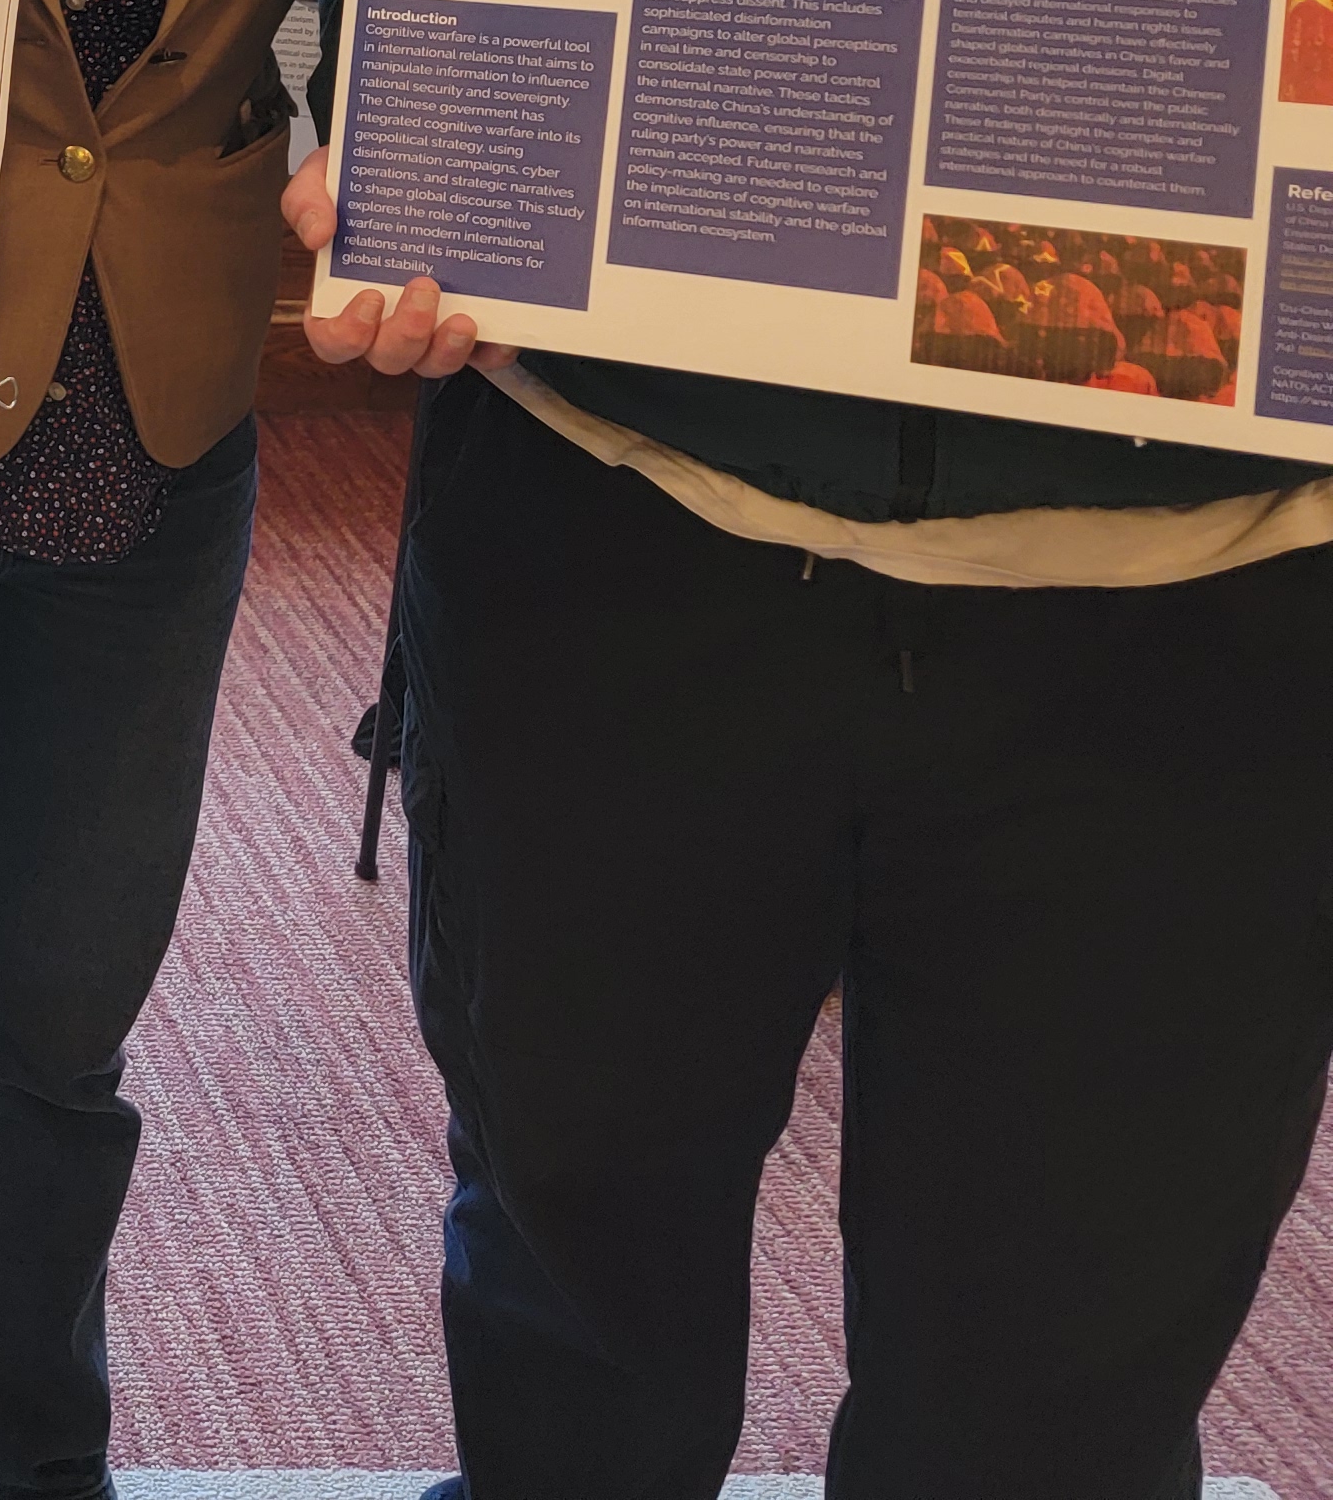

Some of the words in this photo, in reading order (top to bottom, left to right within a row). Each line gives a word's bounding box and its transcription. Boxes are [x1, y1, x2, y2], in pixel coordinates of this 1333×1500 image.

[367, 7, 457, 24] Introduction
[365, 23, 425, 38] Cognitive
[427, 30, 476, 42] warfare
[479, 33, 489, 44] is
[491, 36, 499, 44] a
[502, 37, 561, 50] powerful
[564, 40, 590, 52] tool
